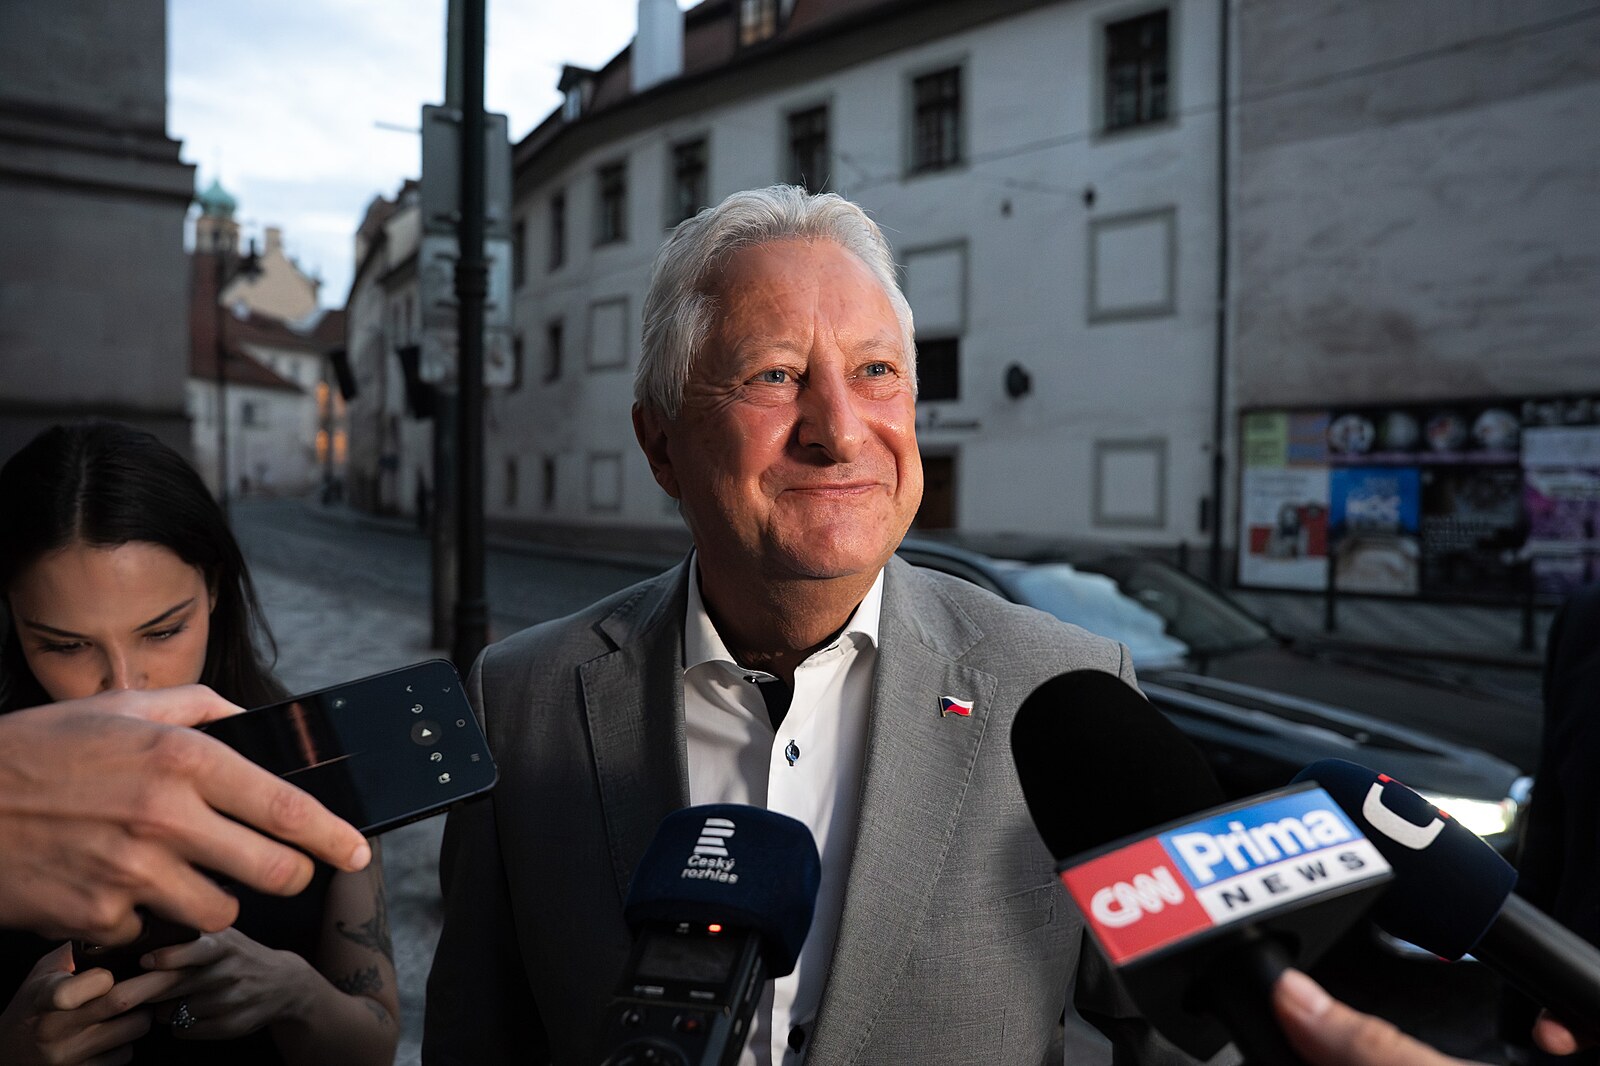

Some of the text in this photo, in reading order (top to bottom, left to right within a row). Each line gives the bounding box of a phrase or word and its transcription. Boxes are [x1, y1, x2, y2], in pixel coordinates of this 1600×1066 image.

[681, 867, 739, 884] rozhlas
[1171, 808, 1353, 885] Prima
[1090, 865, 1185, 928] CNN
[1220, 851, 1367, 909] NEWS
